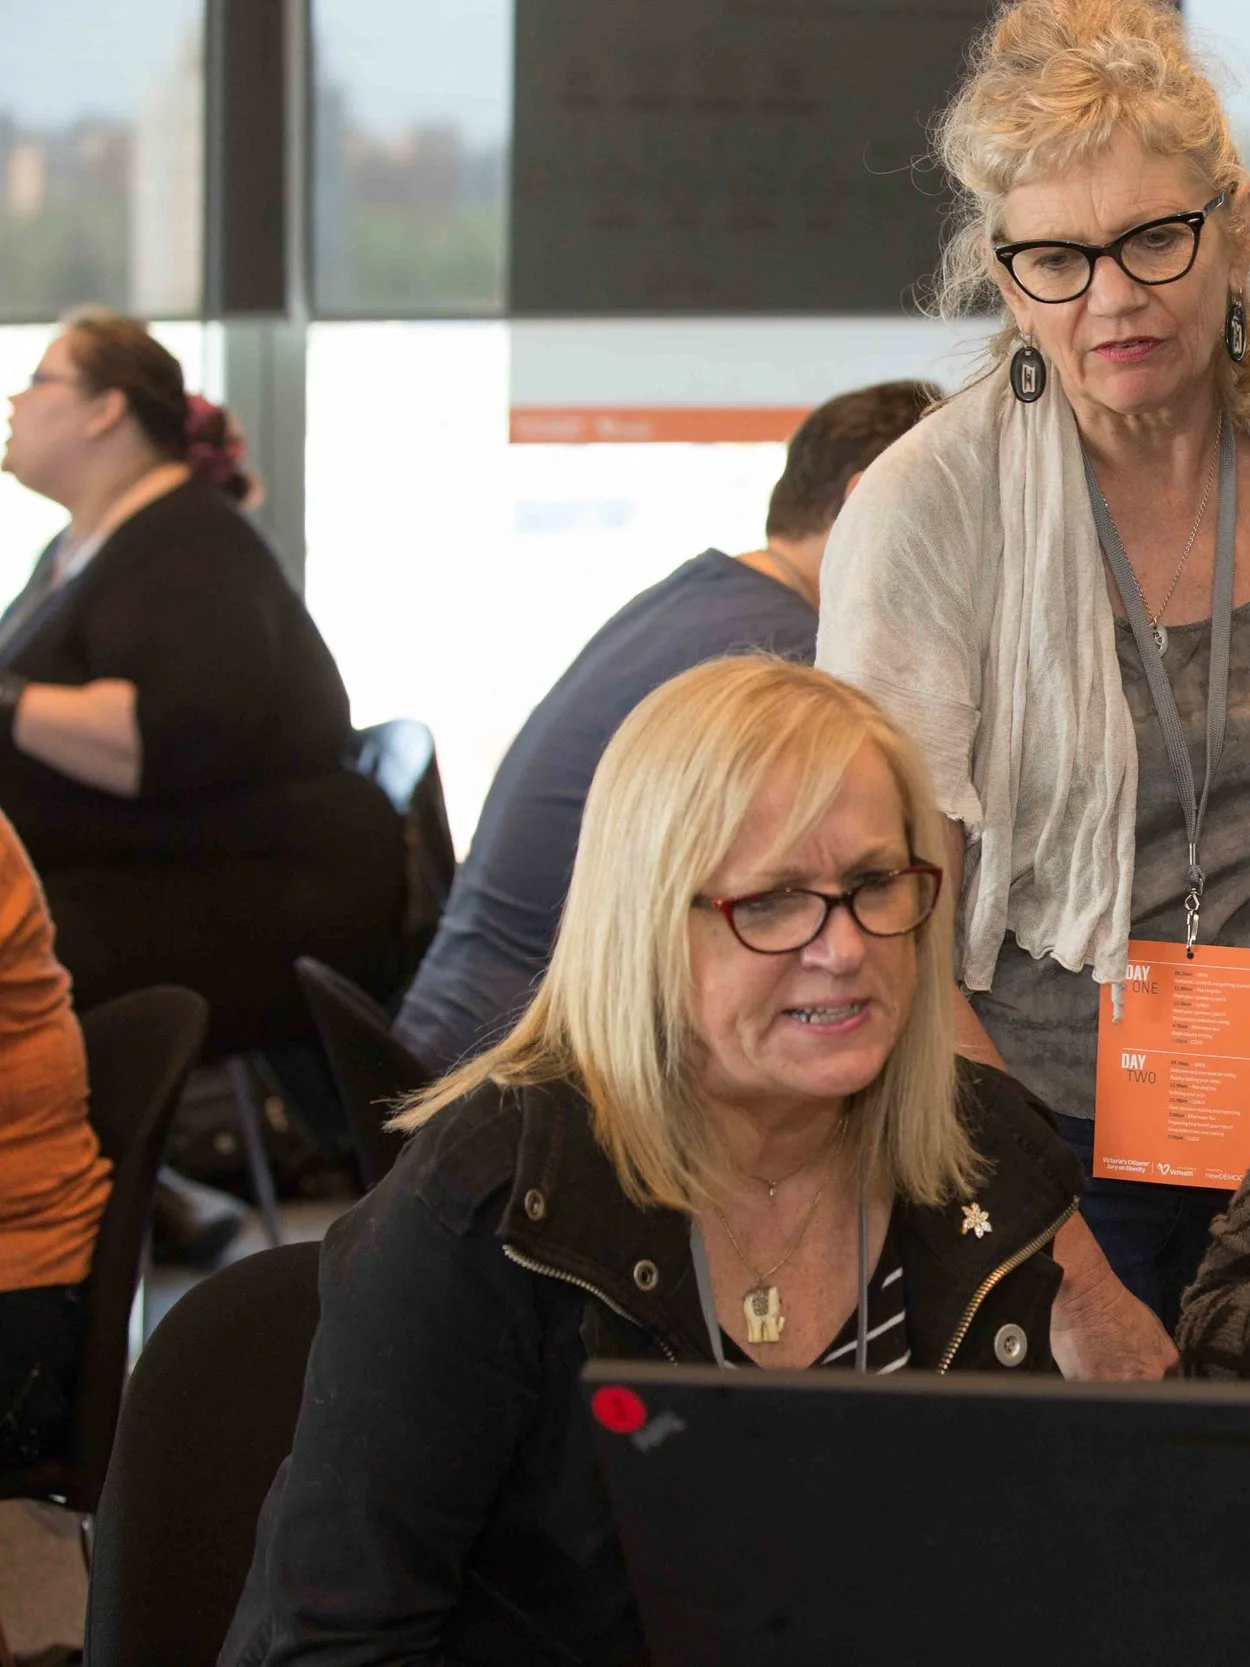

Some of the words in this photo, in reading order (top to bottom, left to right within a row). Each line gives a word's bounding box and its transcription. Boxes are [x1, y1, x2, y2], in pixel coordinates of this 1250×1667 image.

[1125, 964, 1150, 981] DAY
[1132, 980, 1158, 995] ONE
[1121, 1053, 1146, 1070] DAY
[1127, 1069, 1156, 1084] TWO
